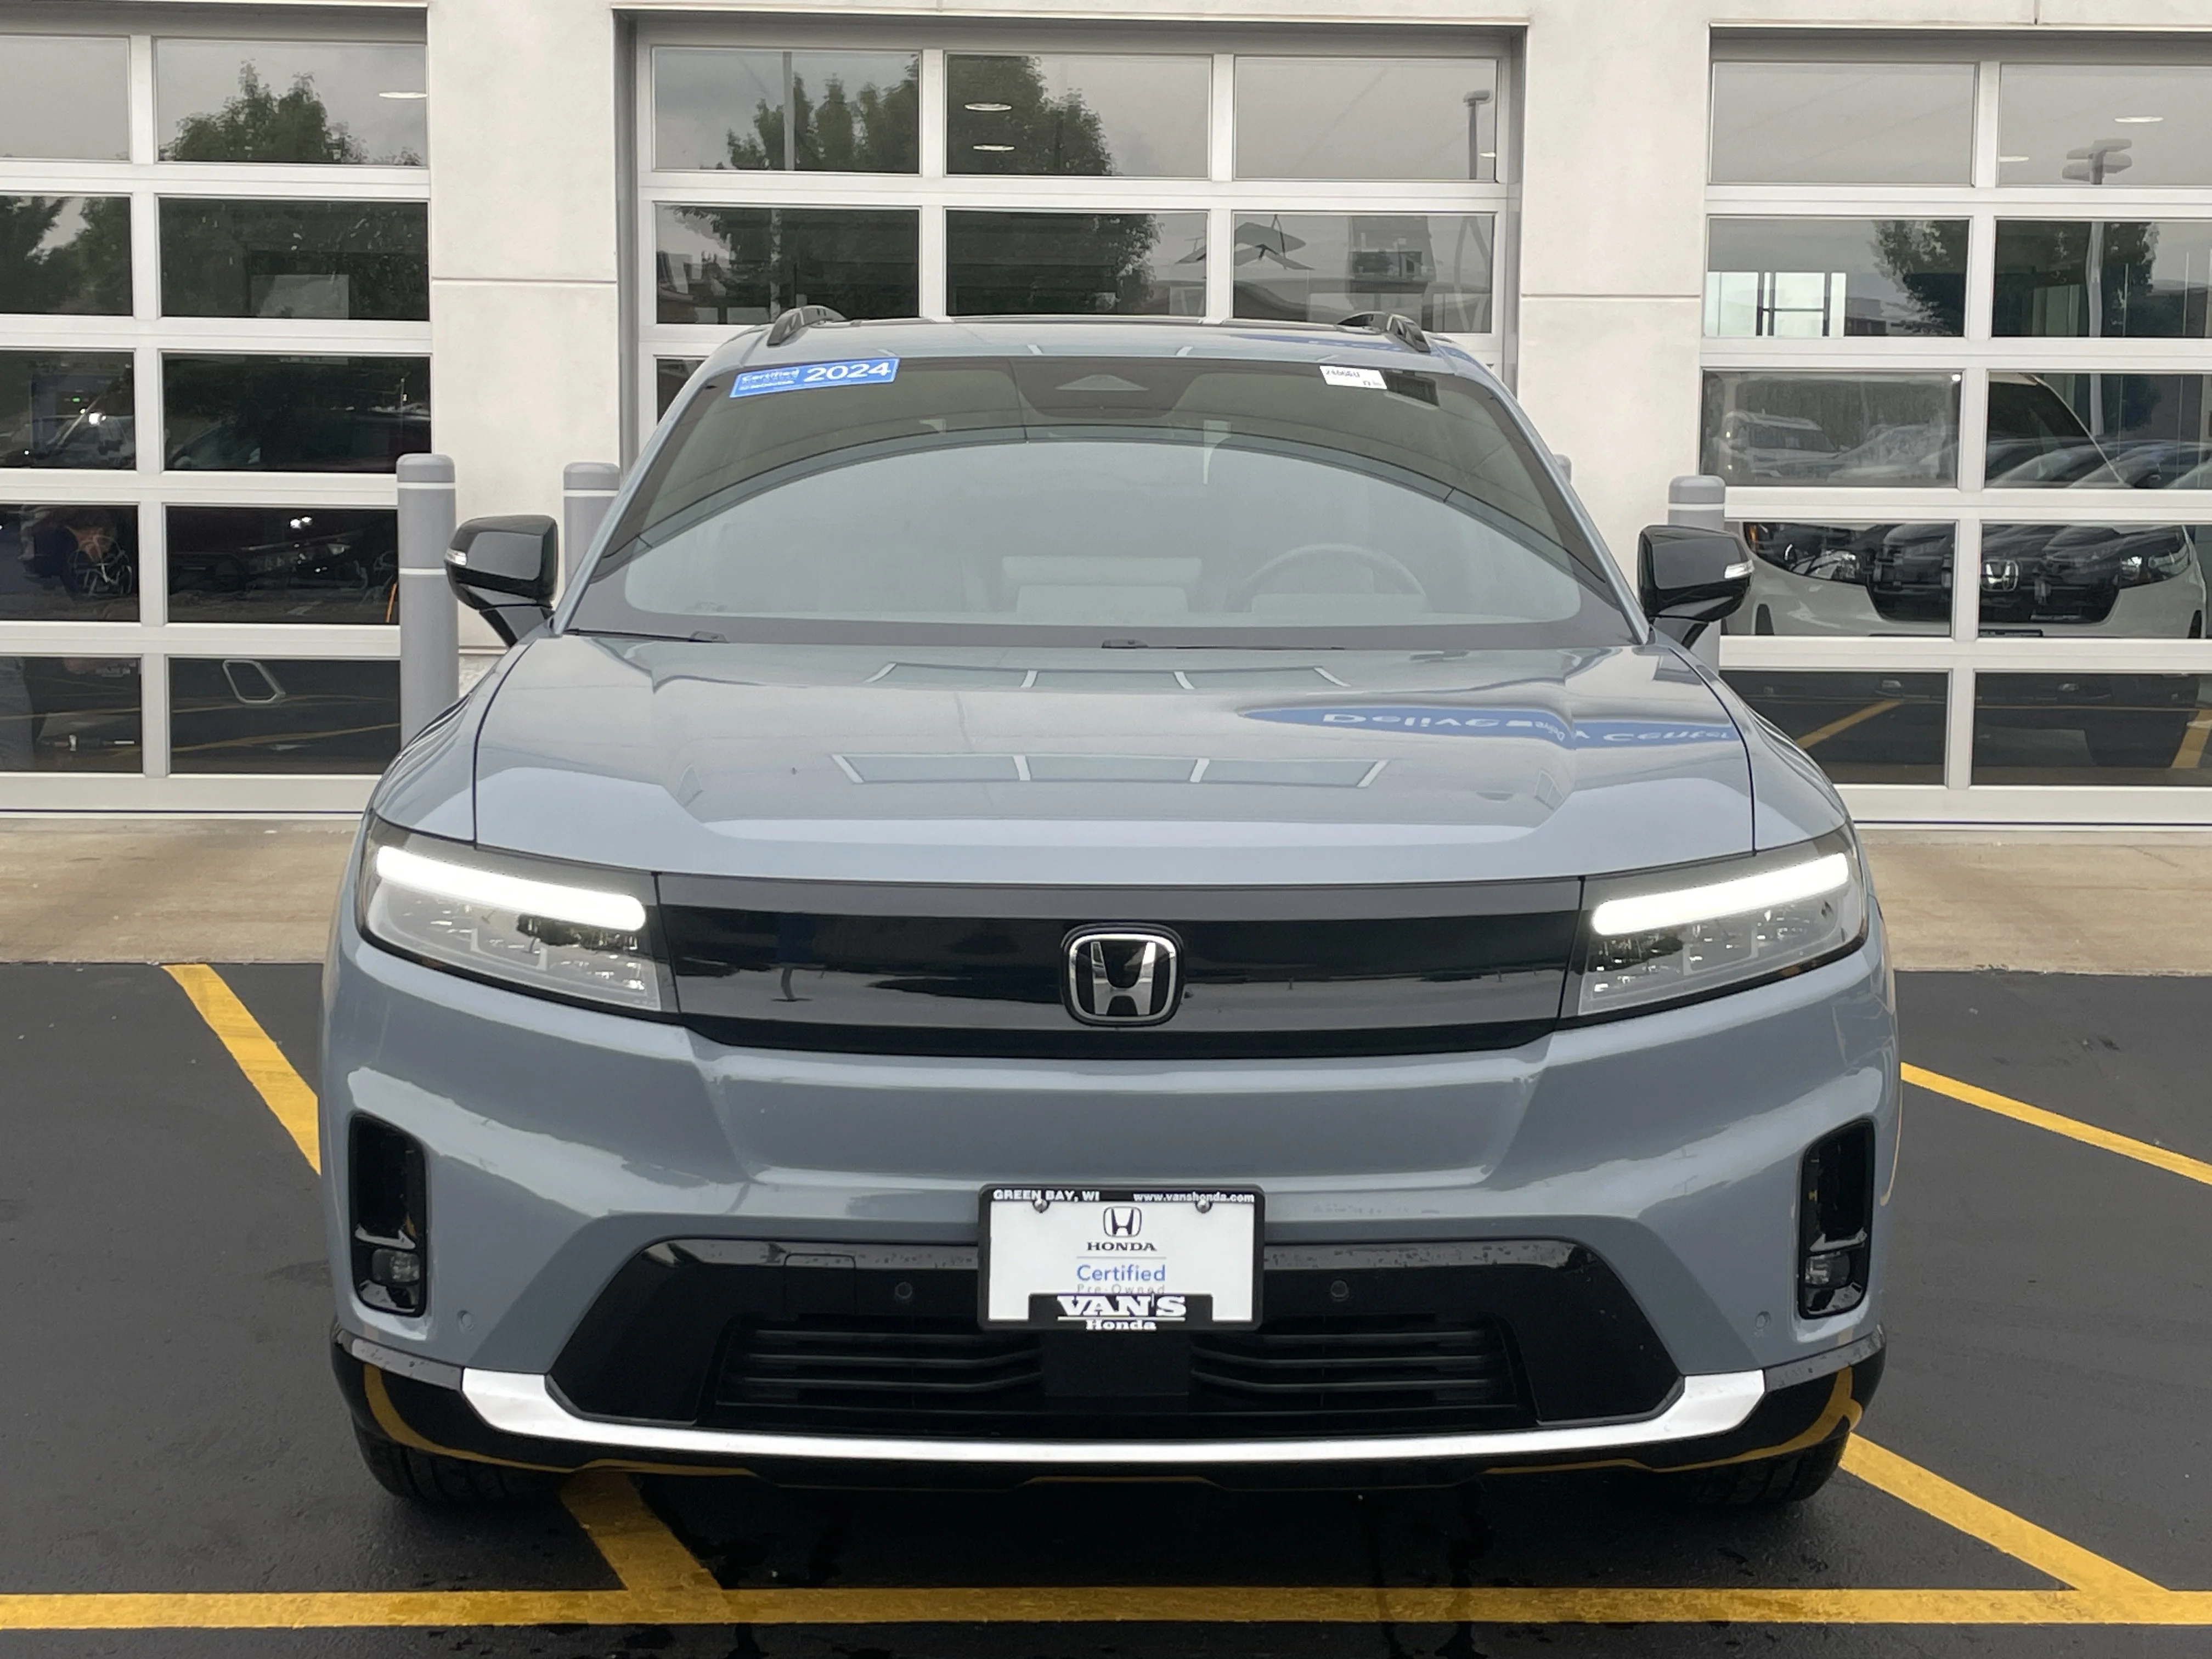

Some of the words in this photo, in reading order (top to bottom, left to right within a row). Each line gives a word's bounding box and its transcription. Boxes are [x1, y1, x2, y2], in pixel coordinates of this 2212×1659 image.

[803, 362, 891, 382] 2024
[993, 1189, 1042, 1200] GREEN
[1045, 1190, 1078, 1203] BAY,
[1082, 1191, 1100, 1201] WI
[1133, 1192, 1255, 1203] www.vanshonda.com
[1086, 1242, 1156, 1251] HONDA
[1076, 1264, 1166, 1282] Certified
[1057, 1295, 1187, 1317] VAN'S
[1086, 1320, 1156, 1330] Honda
